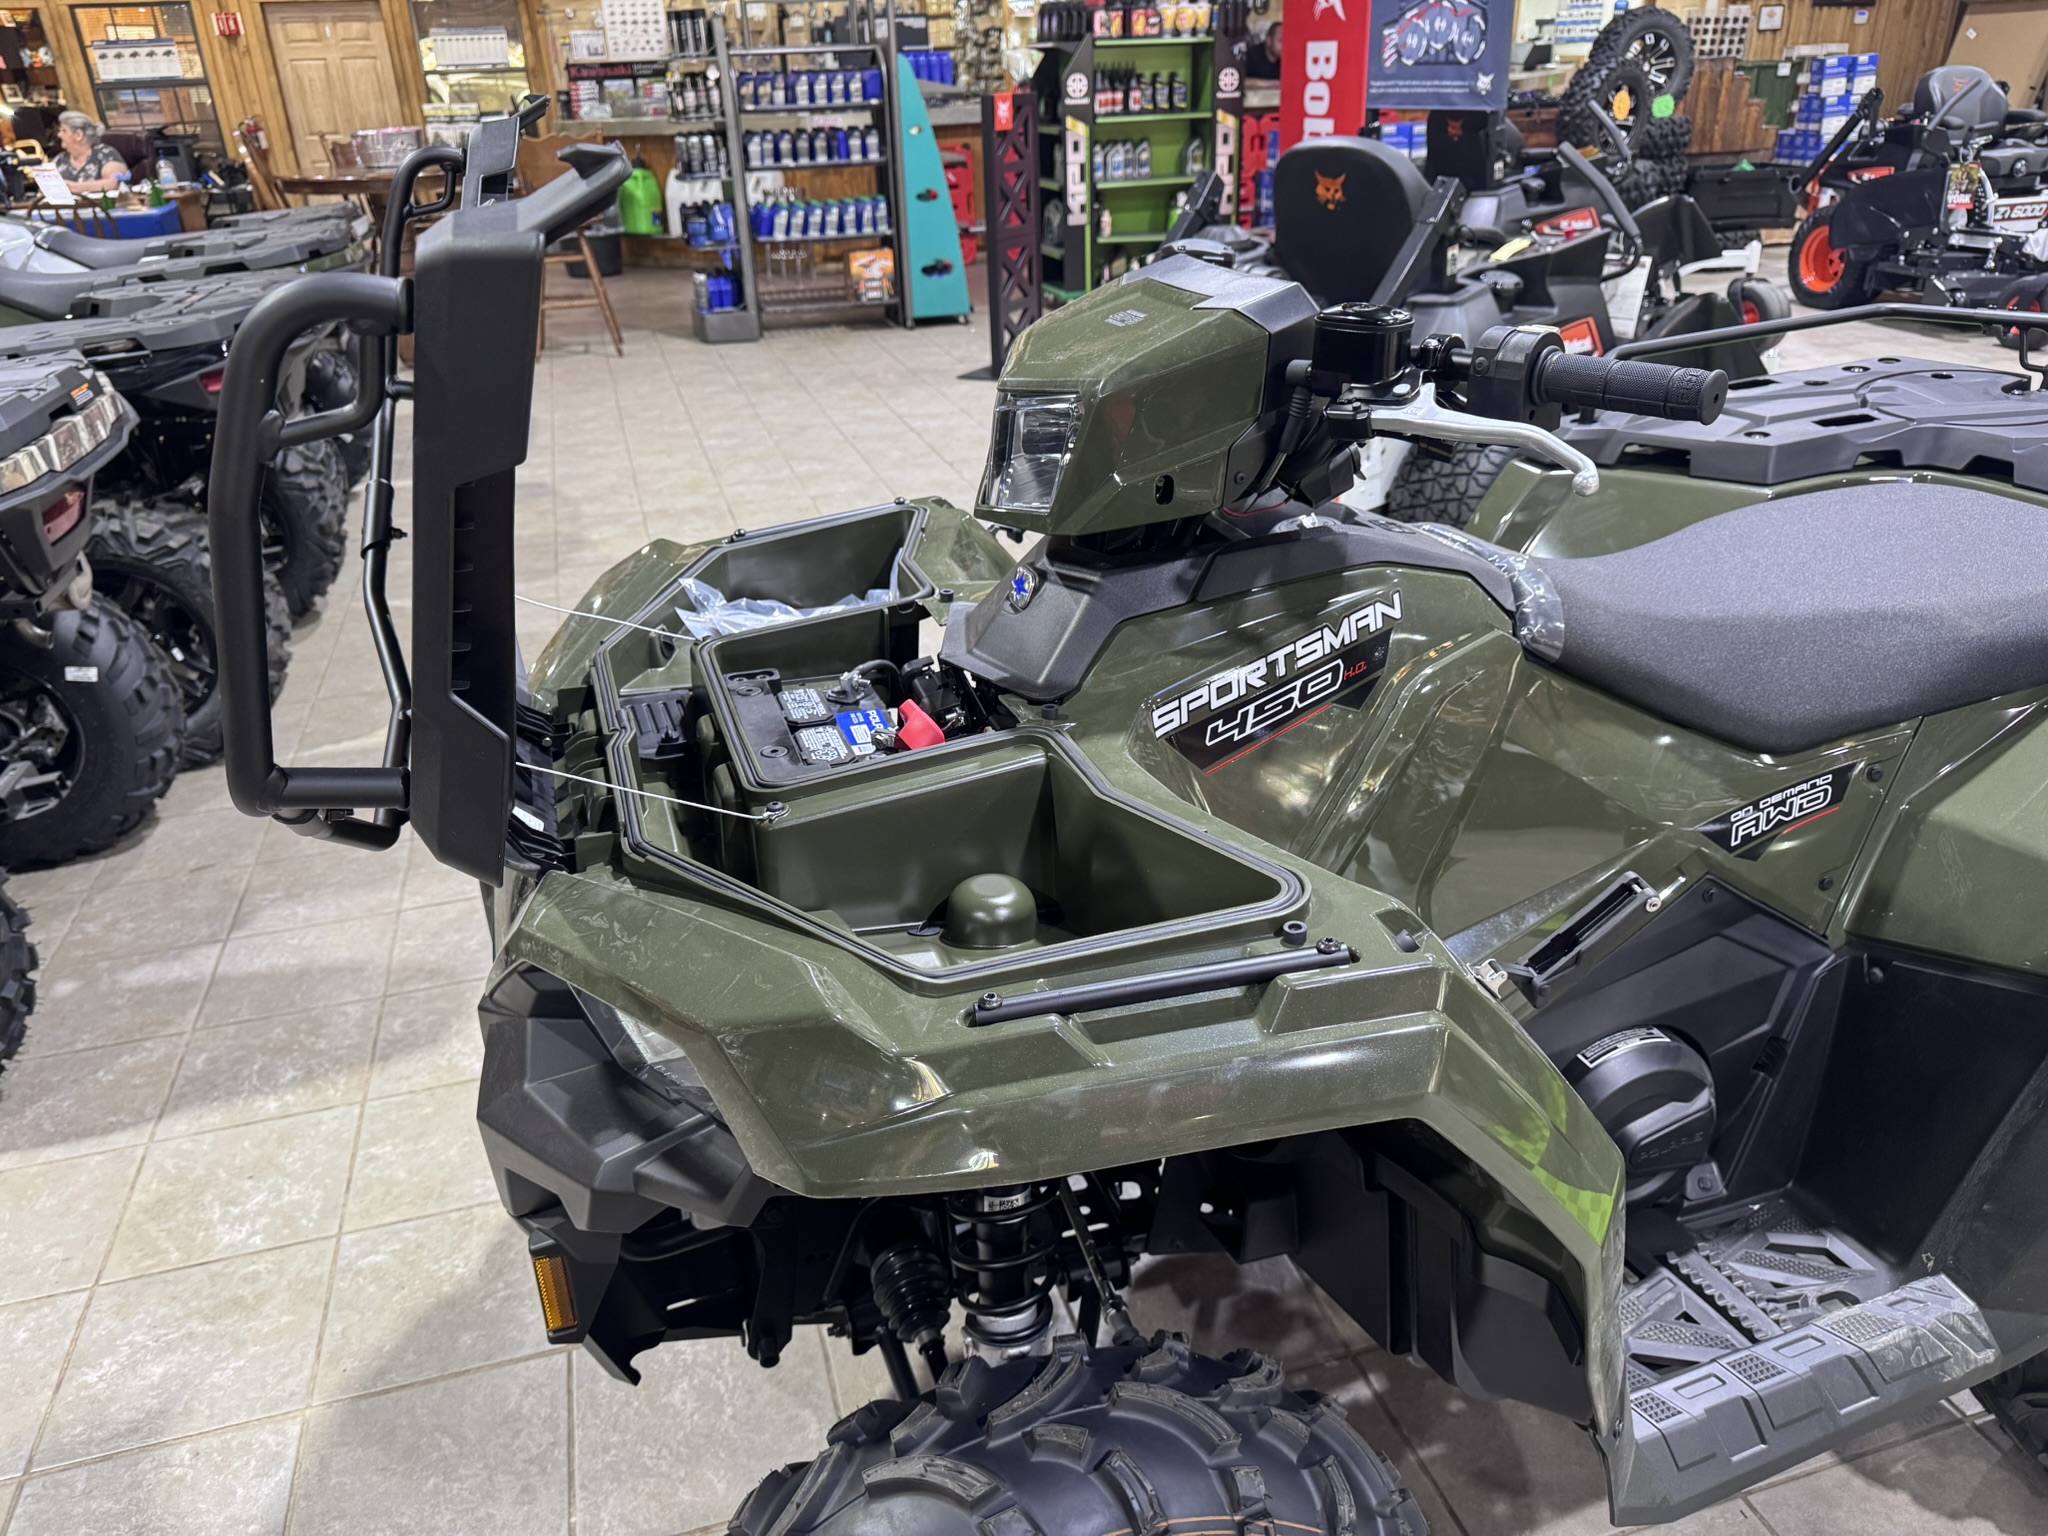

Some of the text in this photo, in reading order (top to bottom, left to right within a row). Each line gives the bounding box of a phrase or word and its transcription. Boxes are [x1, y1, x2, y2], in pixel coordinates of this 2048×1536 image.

[1152, 590, 1402, 739] SPORTSMAN
[1205, 659, 1344, 746] 450
[1730, 774, 1833, 822] ON DEMAND
[1730, 785, 1832, 846] AWD
